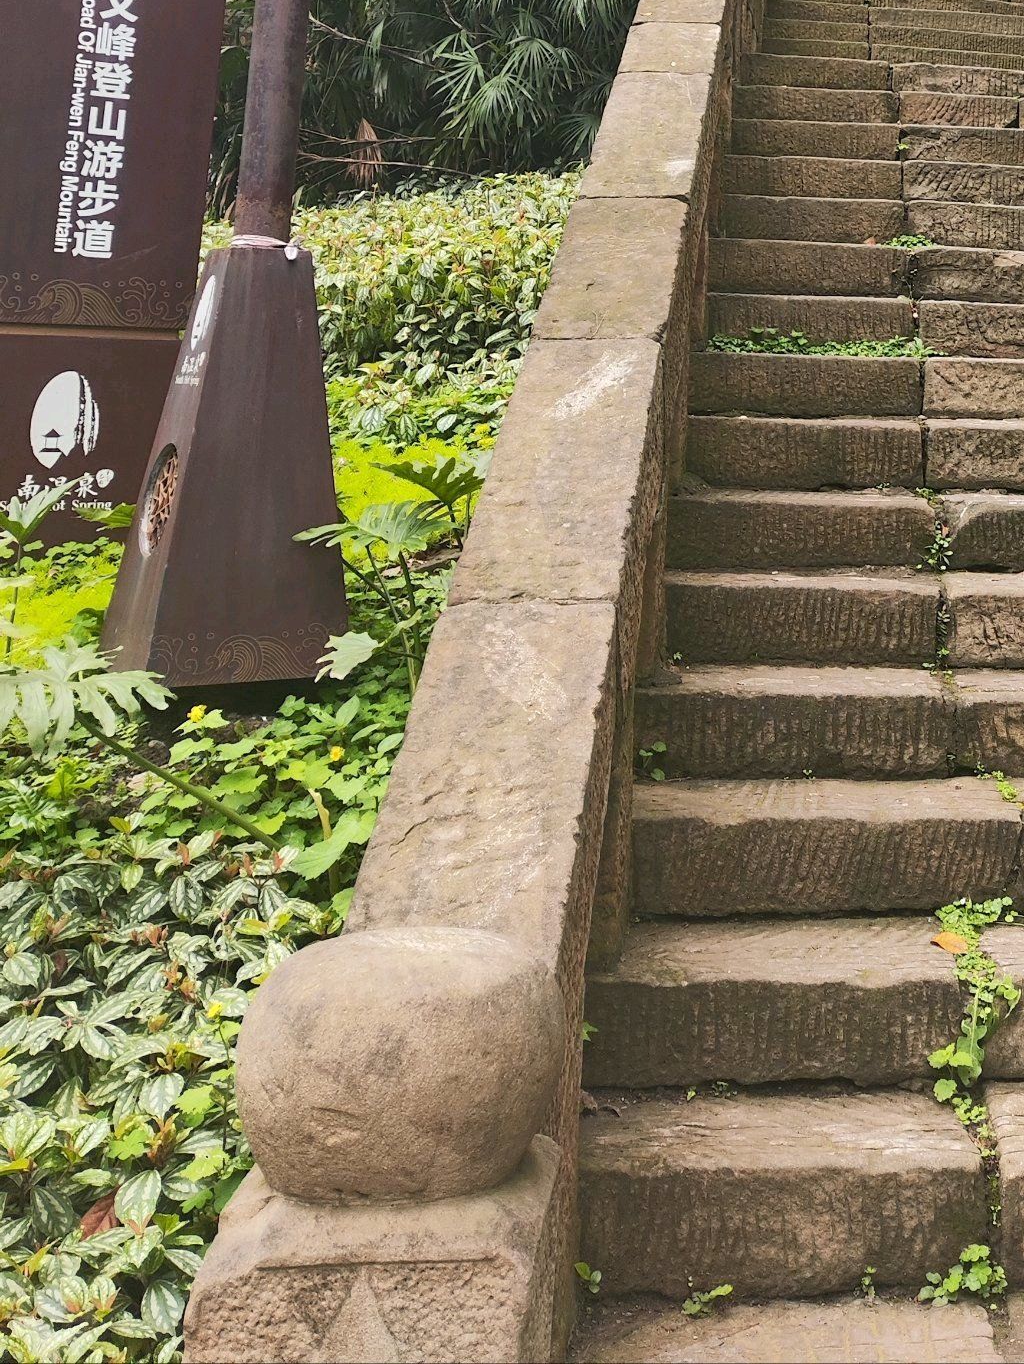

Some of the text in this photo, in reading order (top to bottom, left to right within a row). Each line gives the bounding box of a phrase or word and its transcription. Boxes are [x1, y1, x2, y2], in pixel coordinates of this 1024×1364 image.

[77, 31, 96, 53] Of
[68, 53, 93, 126] Jian-wen
[59, 130, 84, 173] Feng
[53, 175, 79, 253] Mountain
[71, 498, 112, 512] Spring
